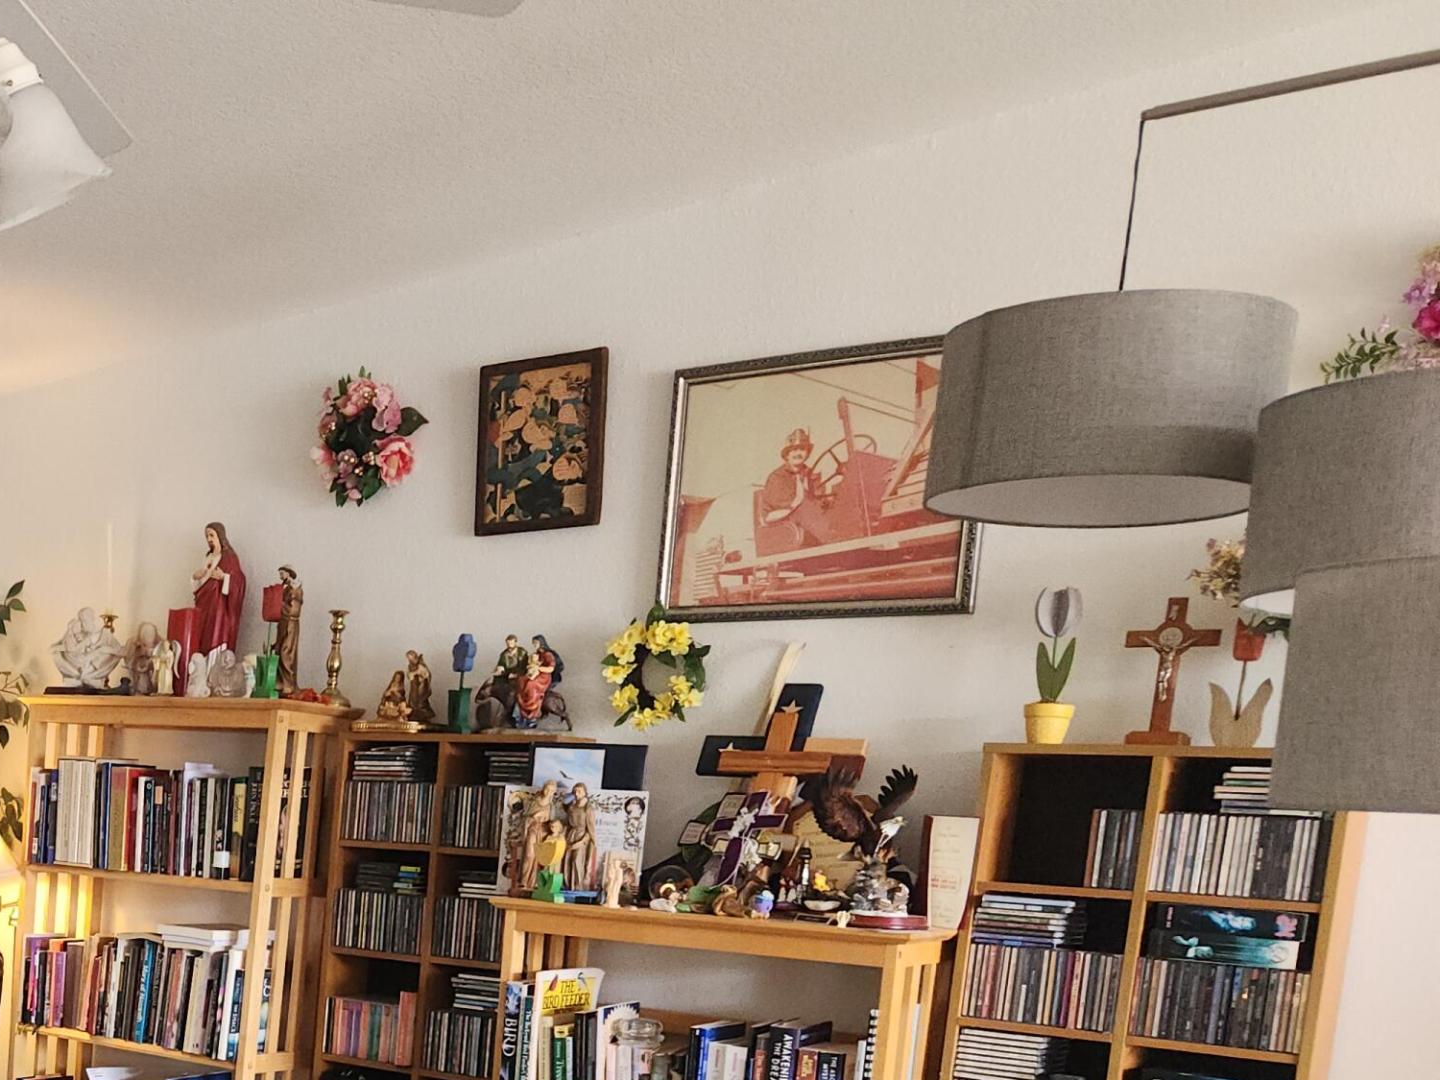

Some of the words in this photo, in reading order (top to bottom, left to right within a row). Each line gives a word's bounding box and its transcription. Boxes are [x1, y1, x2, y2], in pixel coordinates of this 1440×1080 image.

[560, 980, 576, 993] THE
[560, 993, 590, 1007] FEEDER
[503, 1018, 516, 1057] BIRD
[773, 1042, 781, 1055] THE
